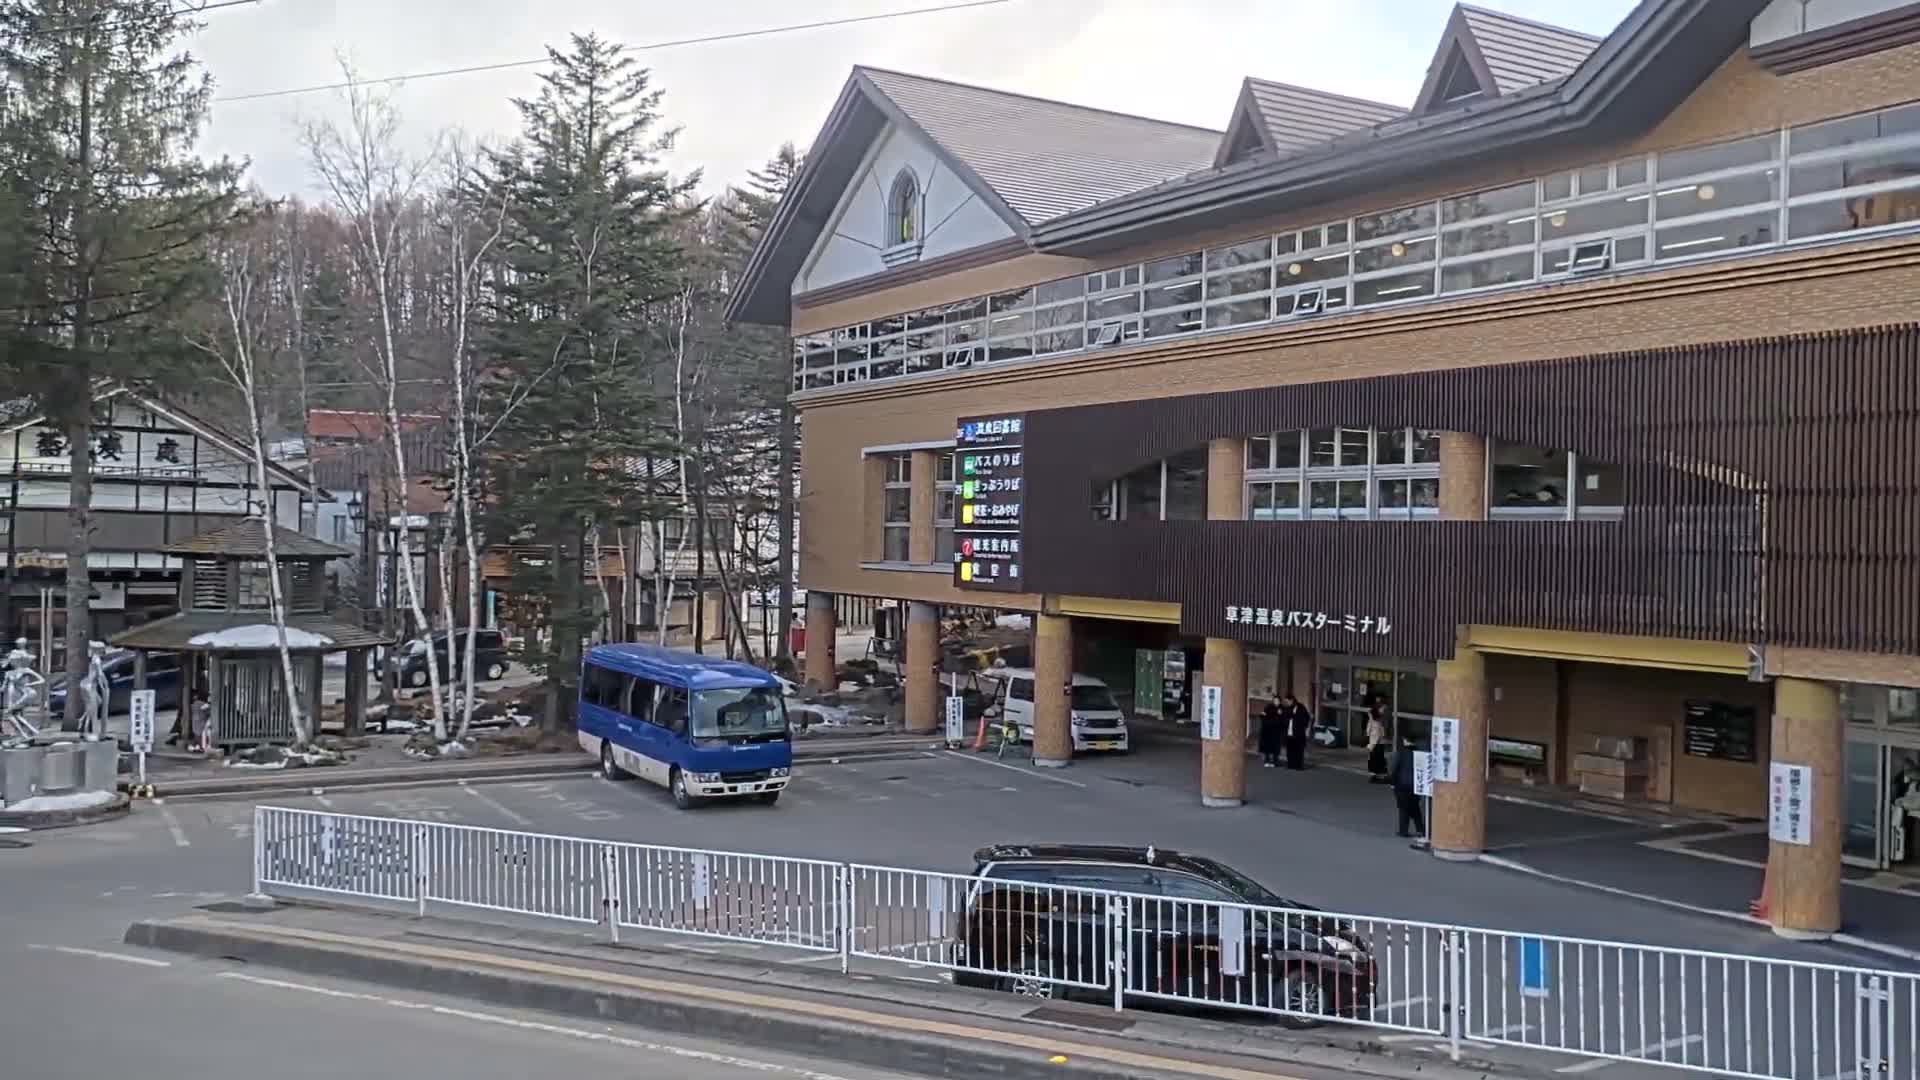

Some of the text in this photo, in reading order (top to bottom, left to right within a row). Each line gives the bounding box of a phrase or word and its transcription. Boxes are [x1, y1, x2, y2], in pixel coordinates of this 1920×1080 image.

[975, 452, 1021, 467] バスのりば
[974, 477, 1021, 492] きっぷうりば
[973, 538, 1019, 552] 観光案内所
[1225, 605, 1392, 636] 草津温泉バスターミナル
